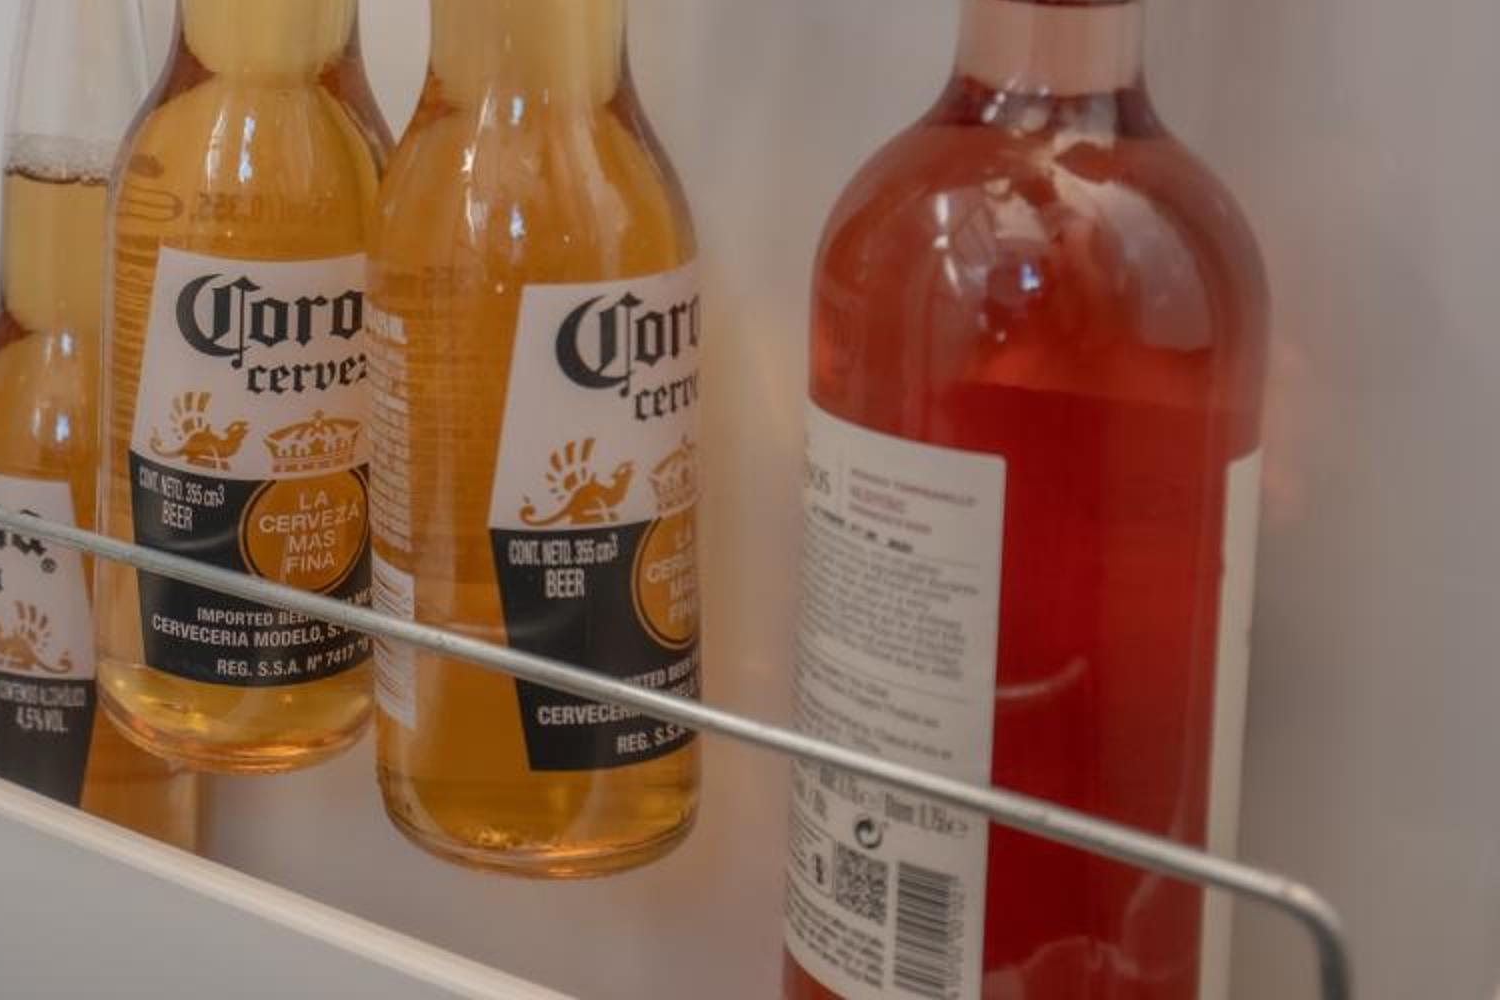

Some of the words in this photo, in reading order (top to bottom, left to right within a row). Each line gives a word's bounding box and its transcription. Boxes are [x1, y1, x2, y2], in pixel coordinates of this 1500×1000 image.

[299, 490, 329, 511] LA
[163, 500, 192, 532] BEER
[260, 501, 359, 534] CERVEZA
[289, 529, 336, 553] MAS
[575, 539, 595, 565] 355
[286, 551, 335, 574] FINA
[545, 568, 585, 598] BEER
[197, 606, 273, 626] IMPORTED
[278, 609, 310, 626] BEE
[152, 614, 249, 647] CERVECERIA
[217, 658, 252, 677] REG.
[326, 644, 355, 667] 7417
[617, 734, 650, 754] REG.
